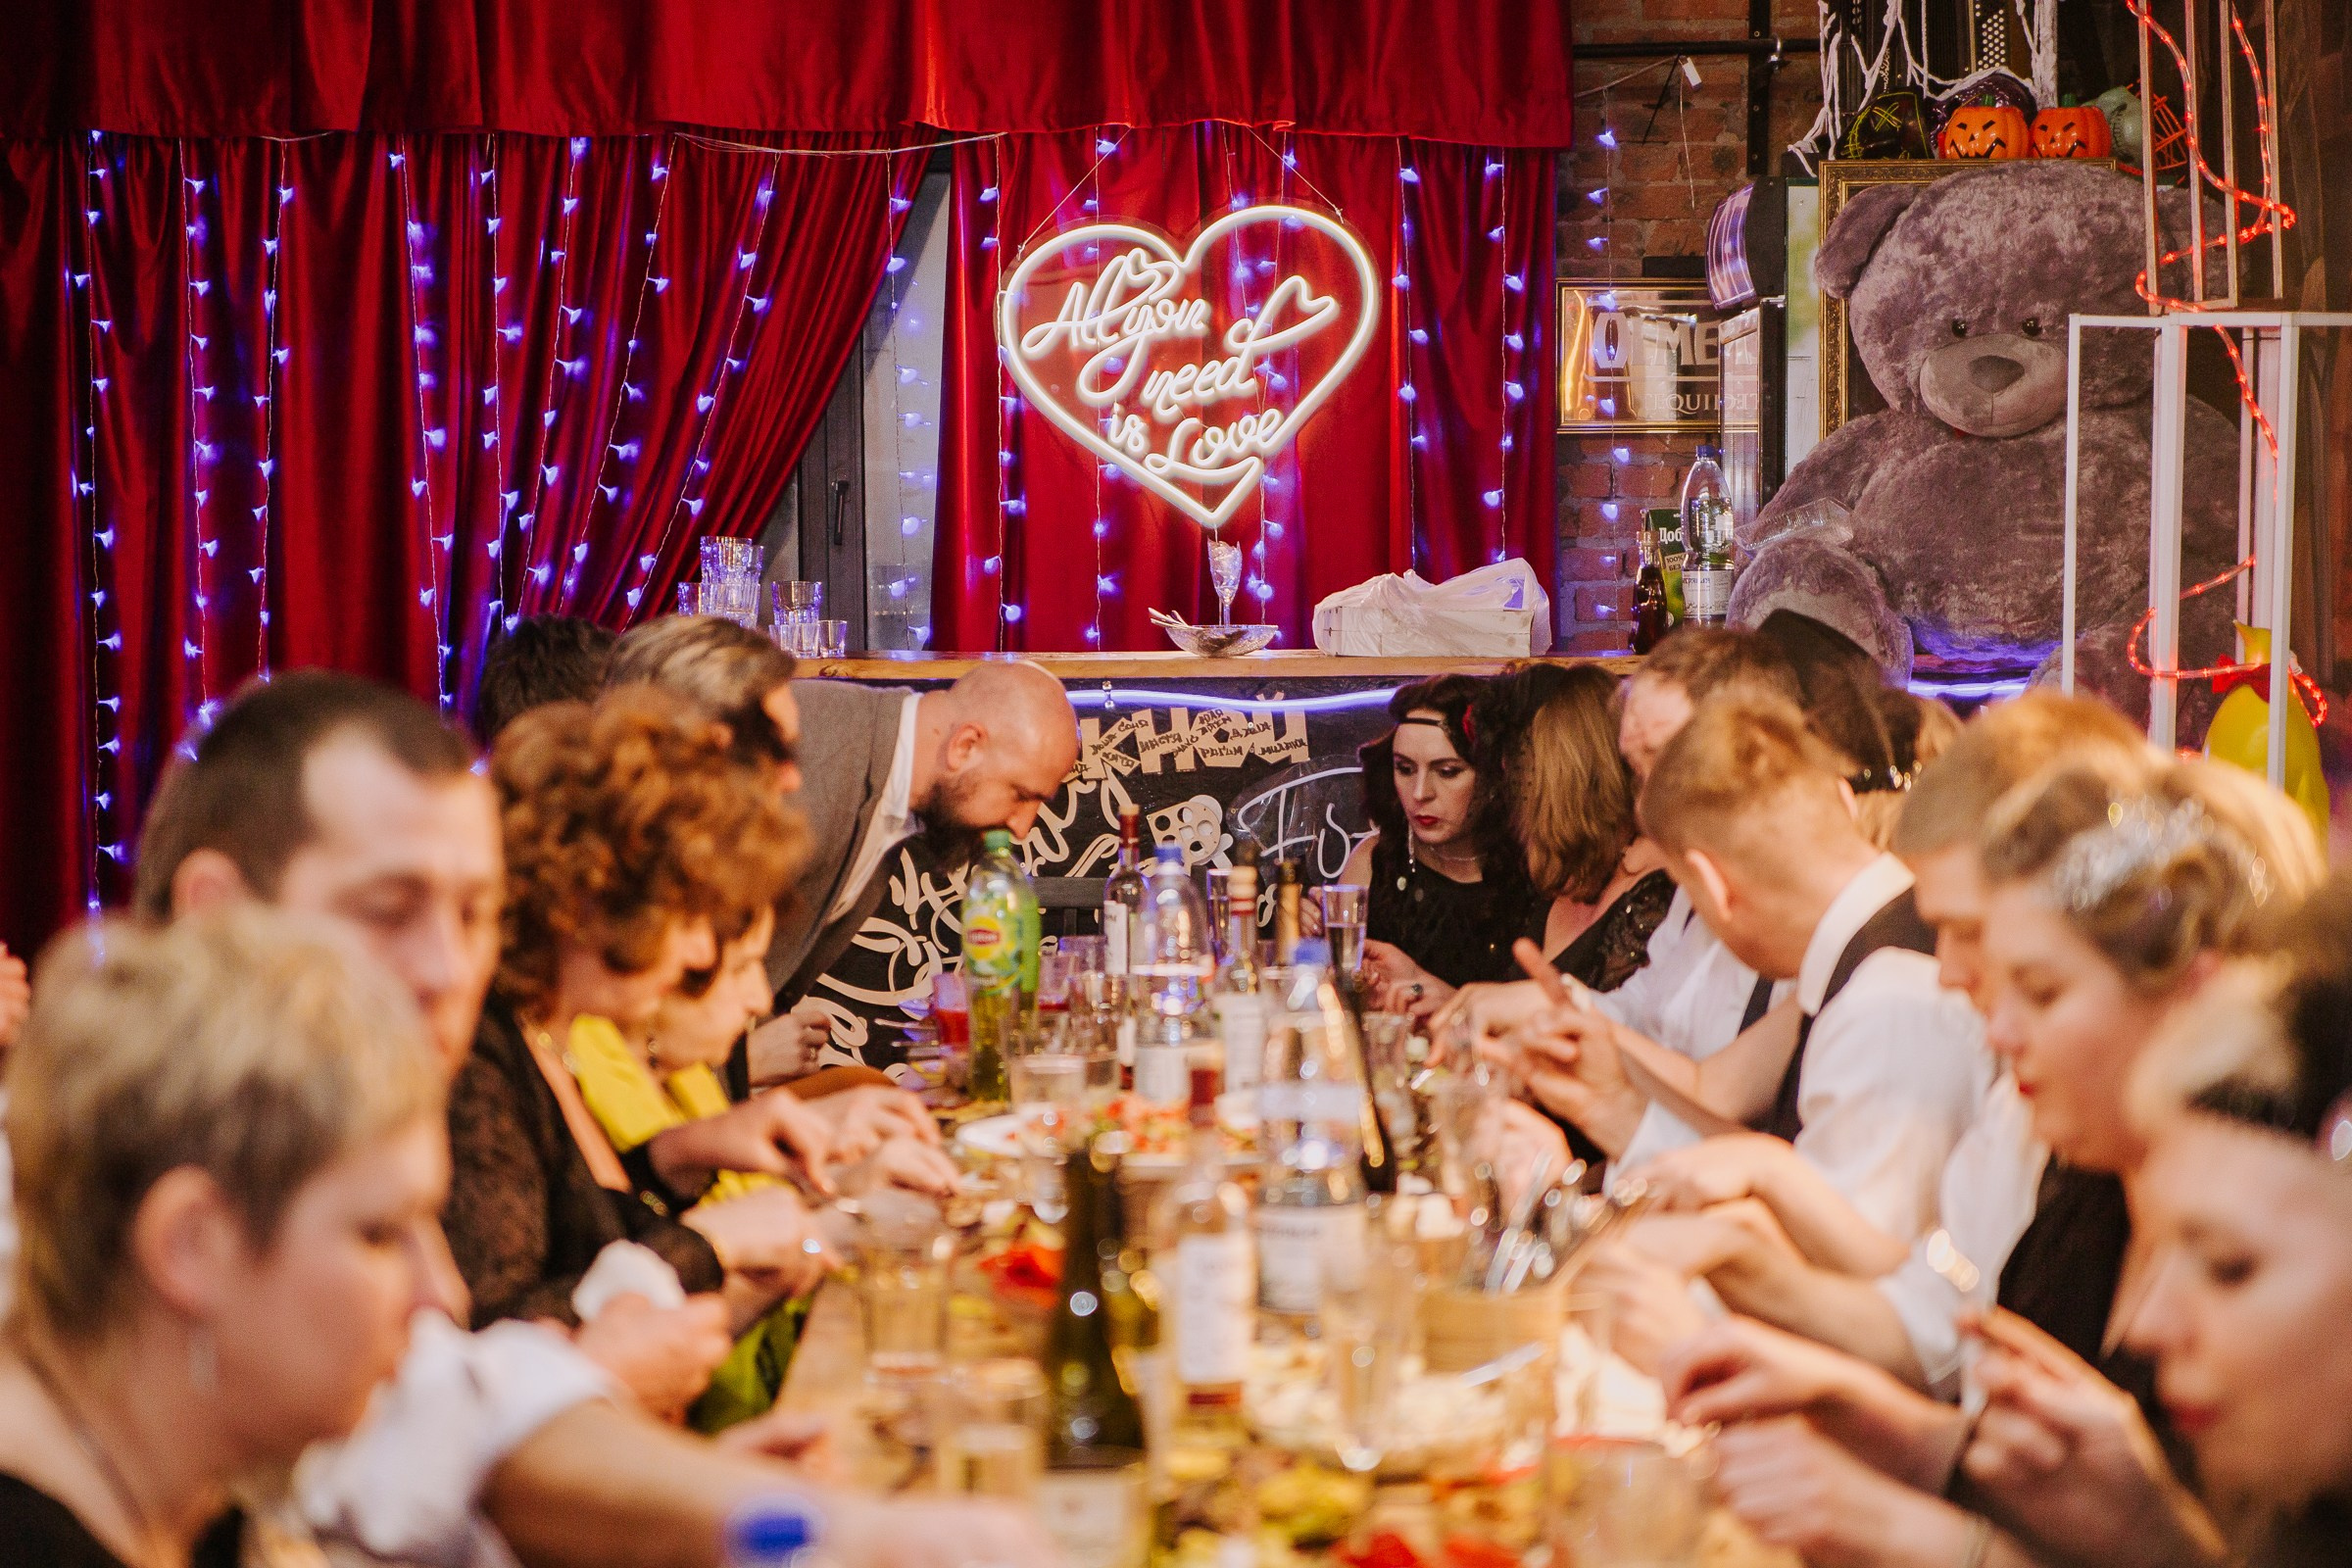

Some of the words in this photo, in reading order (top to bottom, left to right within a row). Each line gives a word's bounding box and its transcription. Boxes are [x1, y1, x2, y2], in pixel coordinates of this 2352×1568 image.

[1021, 248, 1180, 357] All
[1078, 297, 1210, 403] you
[1106, 402, 1148, 459] is
[1145, 408, 1285, 478] Love
[1659, 526, 1682, 544] Доб
[1063, 691, 1310, 782] КНОЙ
